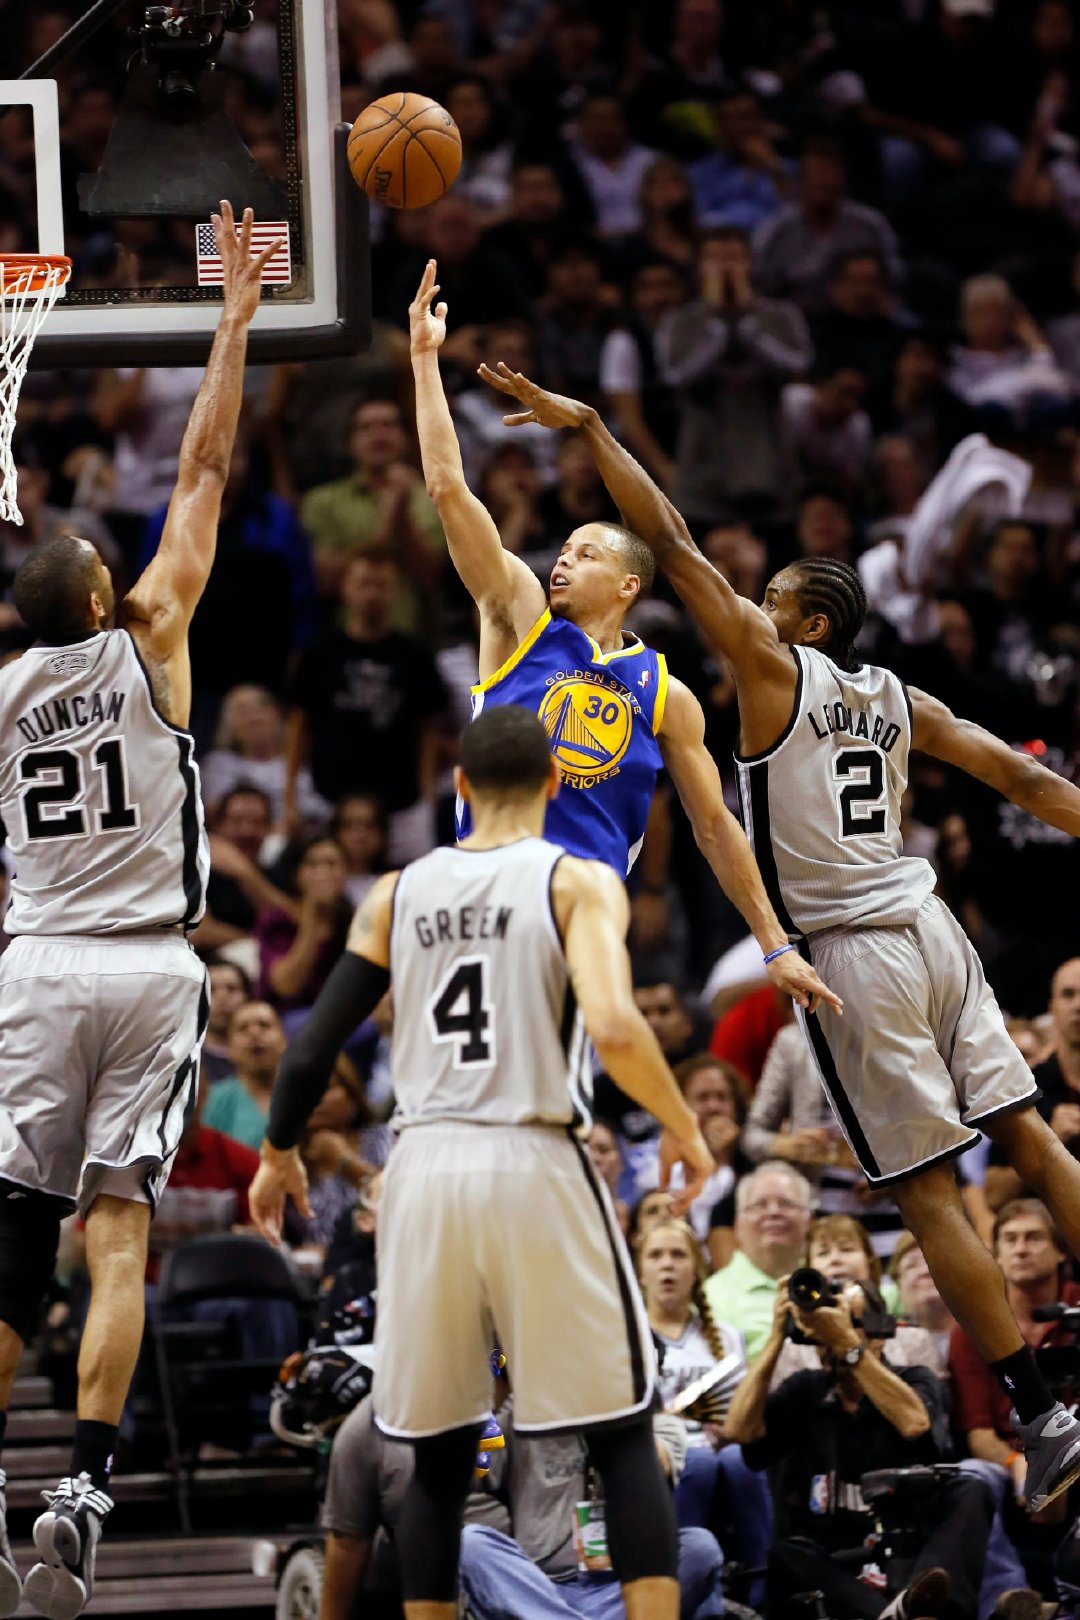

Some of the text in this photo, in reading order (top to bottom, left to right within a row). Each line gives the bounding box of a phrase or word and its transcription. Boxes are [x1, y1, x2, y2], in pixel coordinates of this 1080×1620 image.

[545, 669, 642, 715] GOLDEN STATE
[583, 695, 619, 725] 30
[16, 692, 125, 743] DUNCAN
[807, 702, 901, 752] LEONARD
[16, 735, 141, 843] 21
[560, 767, 621, 789] RRIORS
[831, 746, 889, 841] 2
[415, 905, 513, 948] GREEN
[425, 954, 497, 1070] 4
